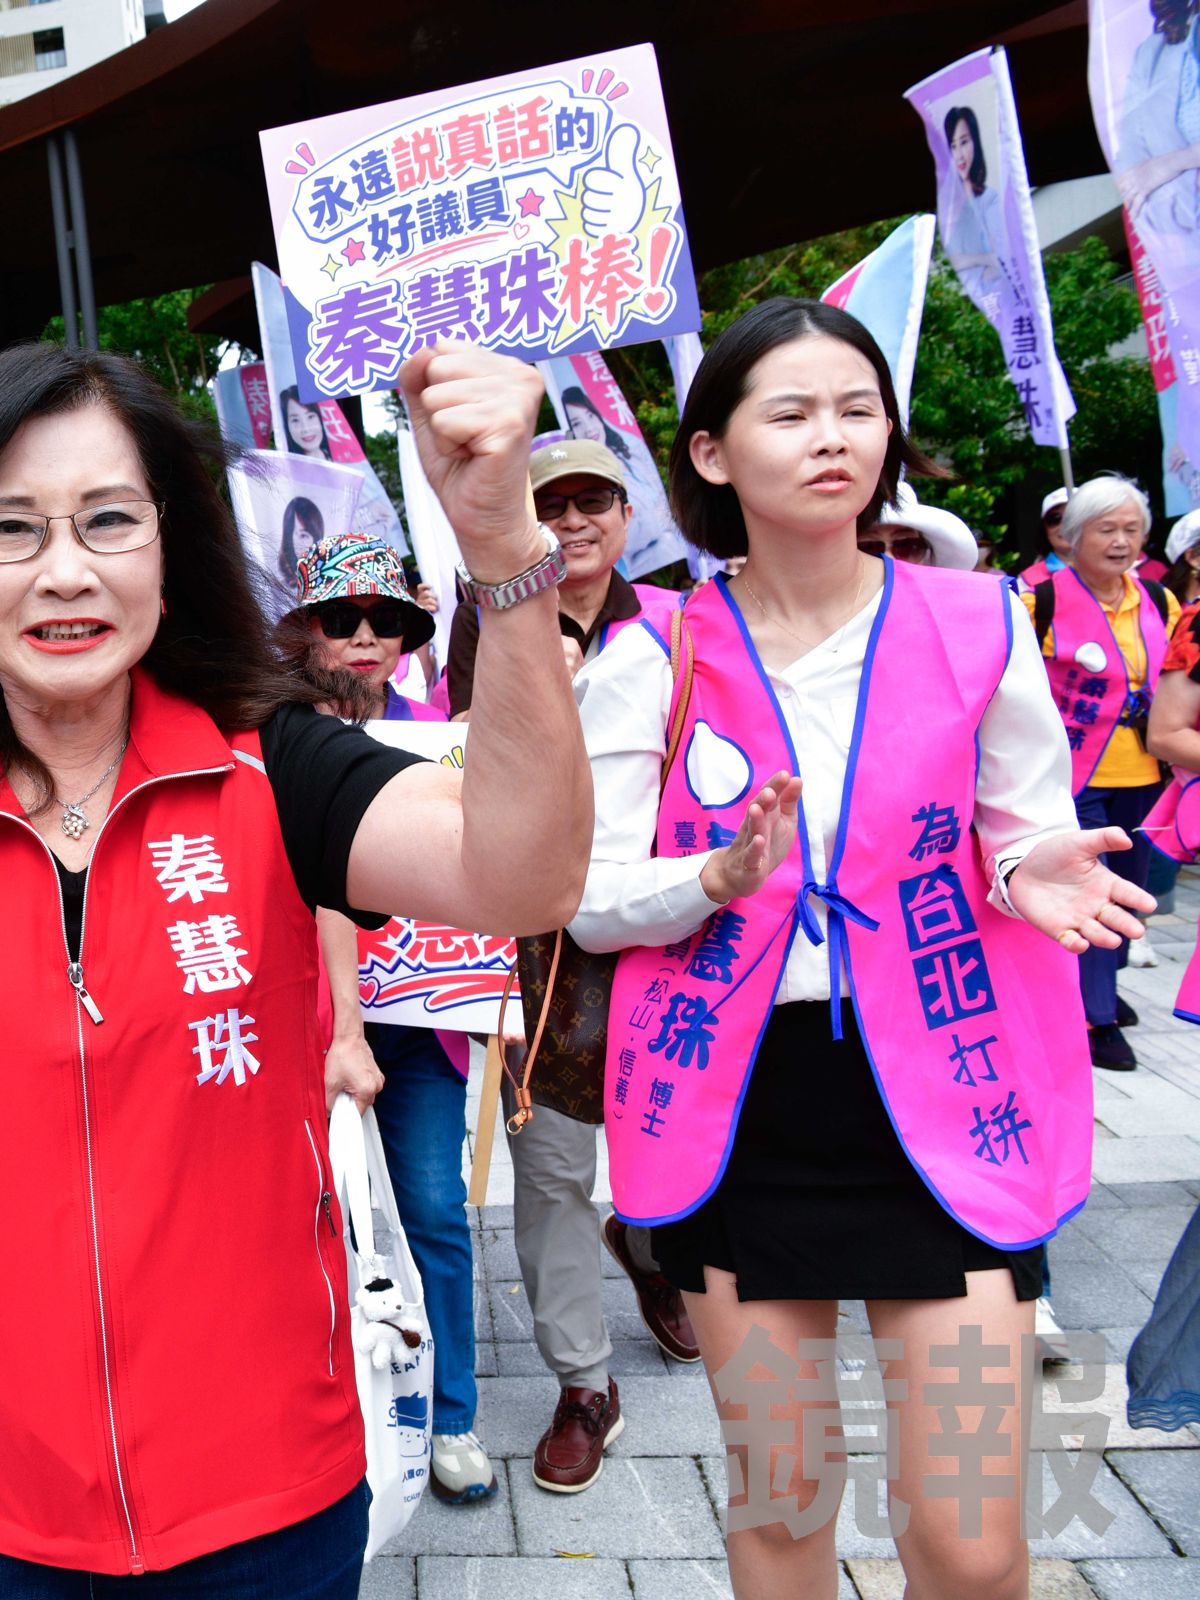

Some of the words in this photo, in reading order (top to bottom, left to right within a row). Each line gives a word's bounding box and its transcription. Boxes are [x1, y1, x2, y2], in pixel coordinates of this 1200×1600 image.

[367, 177, 511, 262] 好議員
[147, 833, 261, 1087] 秦慧珠
[899, 802, 1033, 1167] 為台北打拼
[641, 1077, 675, 1138] 博士
